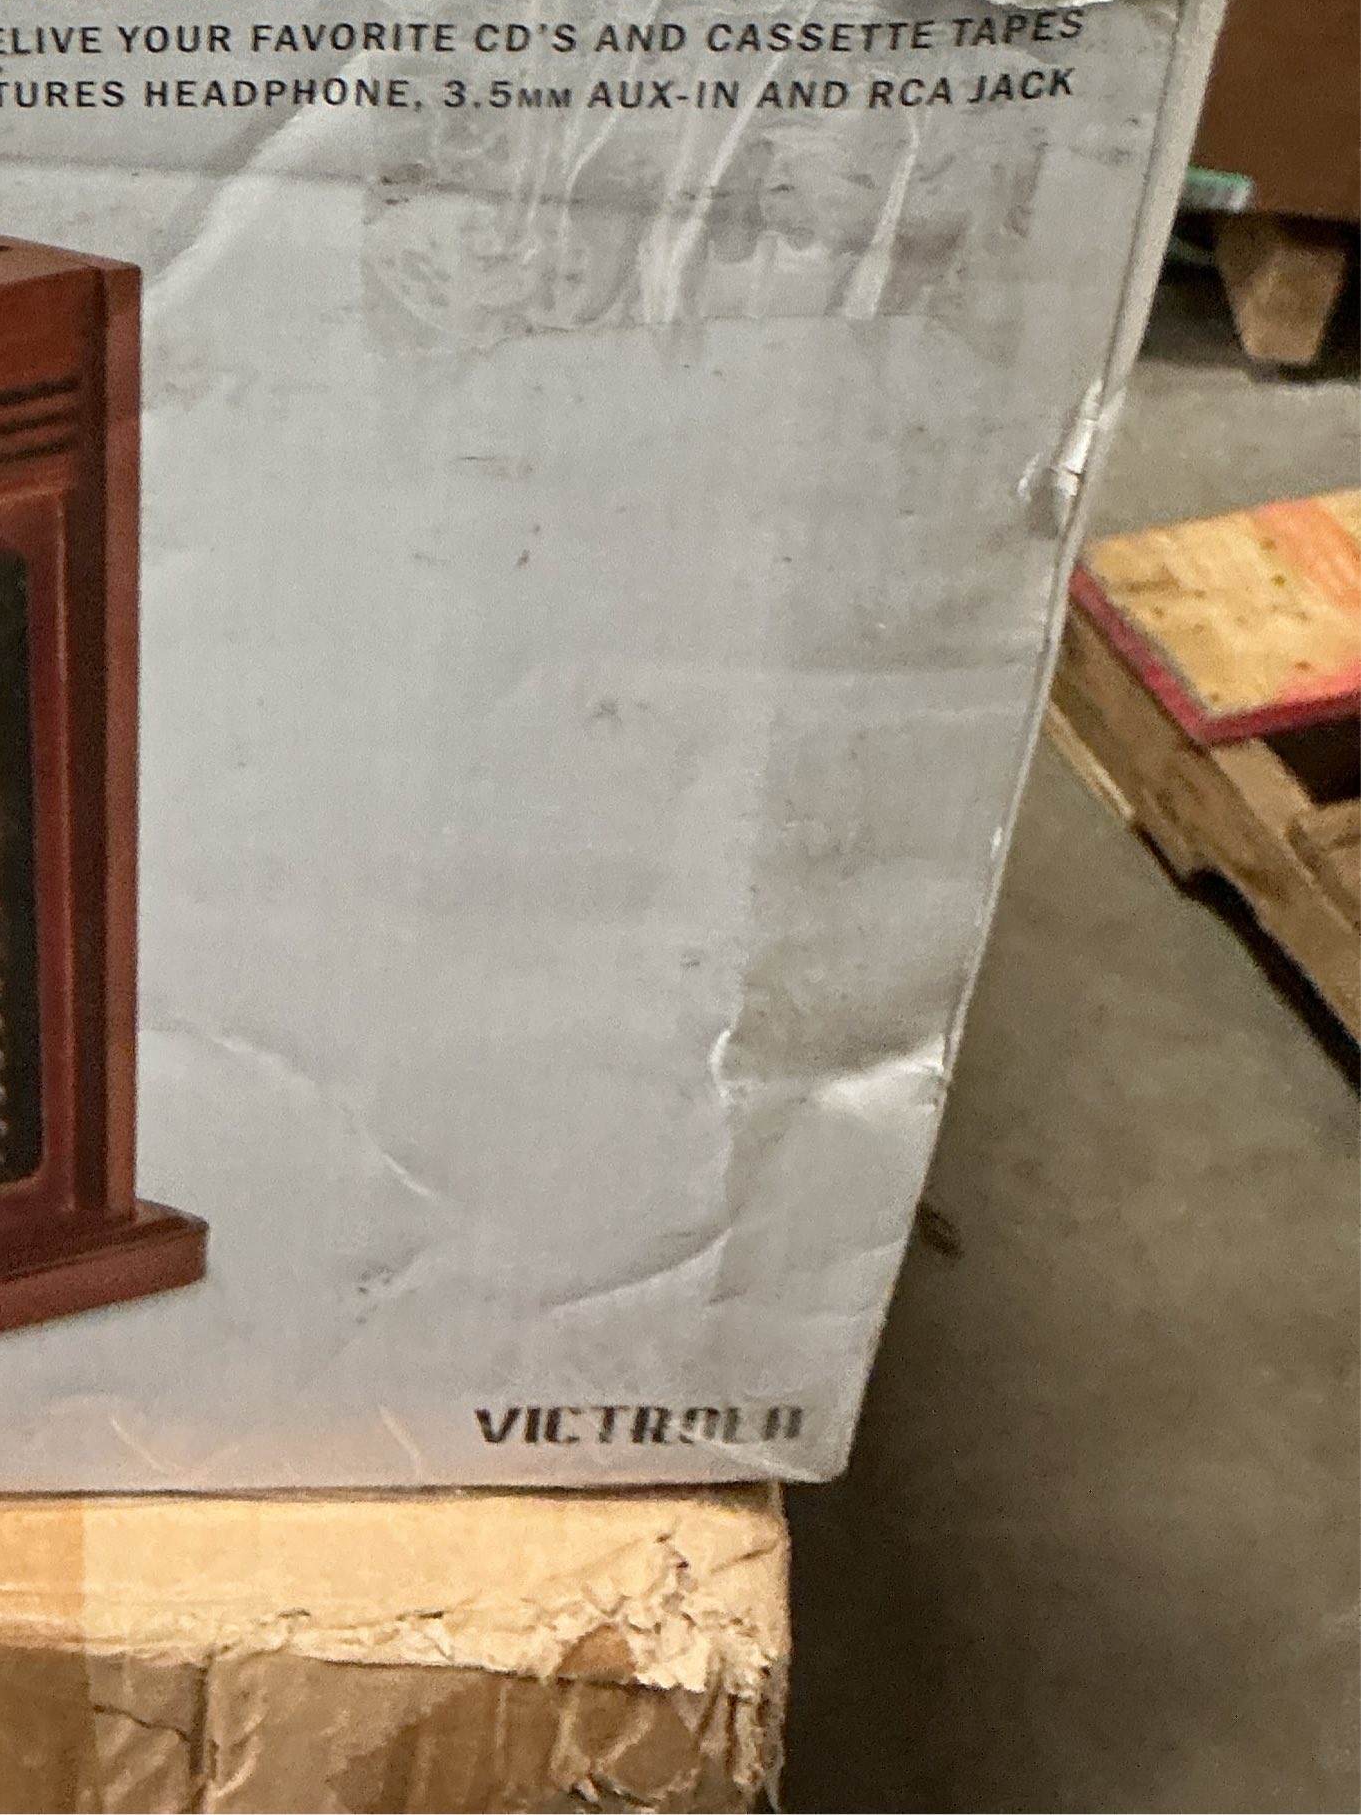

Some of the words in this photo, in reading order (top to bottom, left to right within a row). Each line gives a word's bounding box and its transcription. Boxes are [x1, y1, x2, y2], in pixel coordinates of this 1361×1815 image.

[117, 24, 233, 54] YOUR
[249, 22, 456, 53] FAVORITE
[475, 22, 577, 53] CD'S
[594, 23, 686, 53] AND
[706, 18, 935, 54] CASSETTE
[951, 9, 1085, 48] TAPES
[586, 79, 741, 111] AUX-IN
[757, 79, 848, 110] AND
[866, 76, 953, 110] RCA
[966, 66, 1076, 106] JACK
